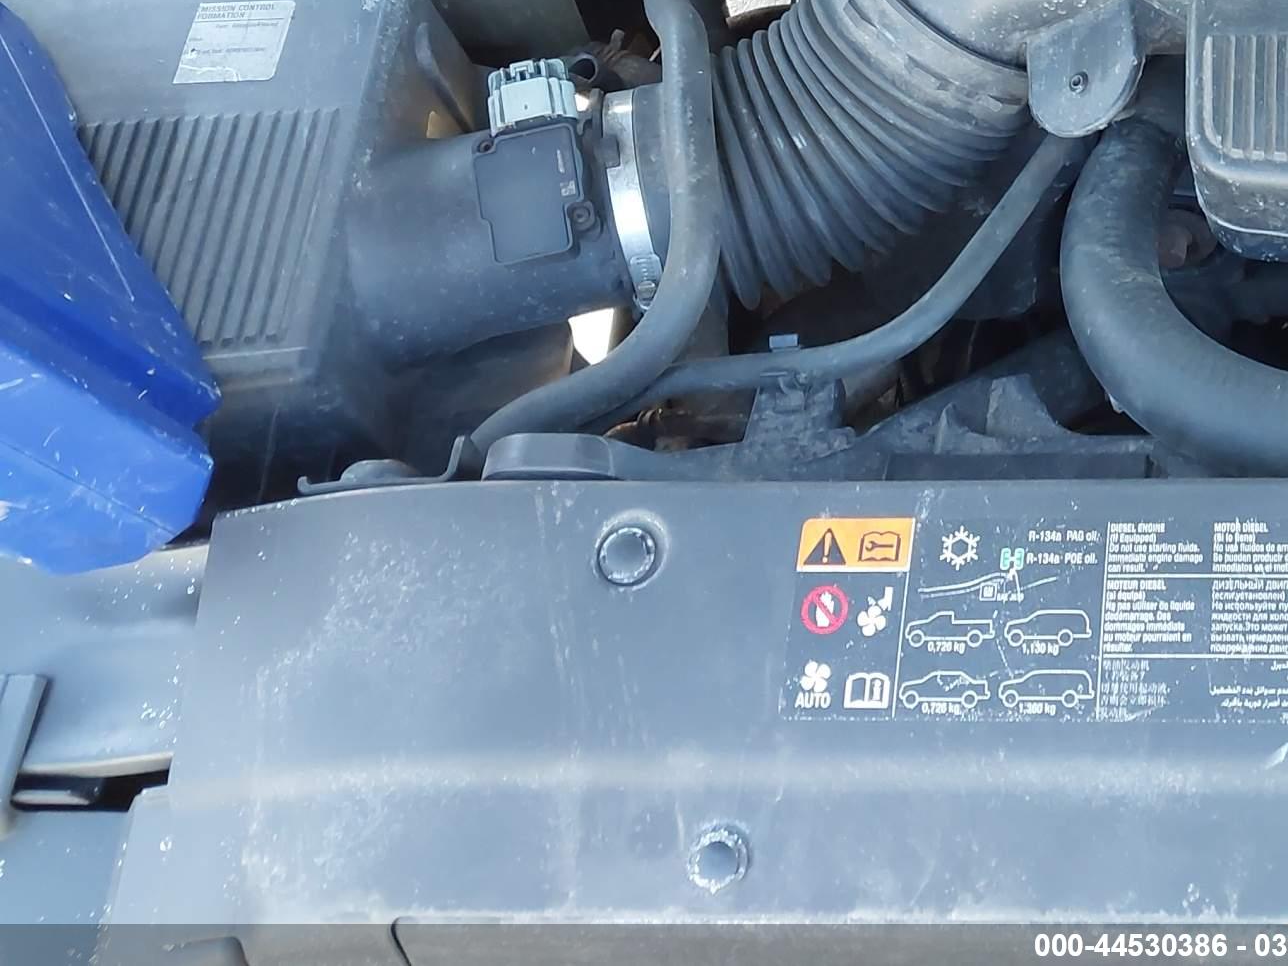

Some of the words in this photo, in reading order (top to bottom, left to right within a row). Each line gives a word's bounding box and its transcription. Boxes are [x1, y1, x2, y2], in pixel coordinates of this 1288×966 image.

[1111, 522, 1136, 533] DIESEL
[1138, 522, 1165, 533] ENGINE
[1214, 522, 1241, 533] MOTOR
[1242, 522, 1268, 533] DIESEL
[1109, 543, 1118, 552] Do
[1121, 543, 1133, 552] not
[1149, 543, 1176, 554] starting
[1178, 543, 1200, 552] fluids.
[1266, 543, 1275, 552] de
[1148, 554, 1173, 564] engine
[1174, 553, 1204, 564] damage
[1225, 553, 1251, 564] pueden
[1253, 553, 1283, 564] producir
[1108, 564, 1121, 572] can
[1123, 563, 1145, 572] result.
[1254, 564, 1263, 572] en
[1265, 563, 1272, 572] el
[1107, 580, 1138, 590] MOTEUR
[1140, 580, 1167, 590] DIESEL
[1117, 602, 1131, 611] pas
[1170, 601, 1195, 611] liquide
[1115, 633, 1141, 642] moteur
[1142, 633, 1181, 643] pourraient
[1182, 633, 1192, 642] en
[954, 641, 965, 655] kg
[1047, 643, 1059, 656] kg
[795, 692, 831, 708] AUTO
[948, 703, 960, 716] kg
[1044, 703, 1057, 716] kg
